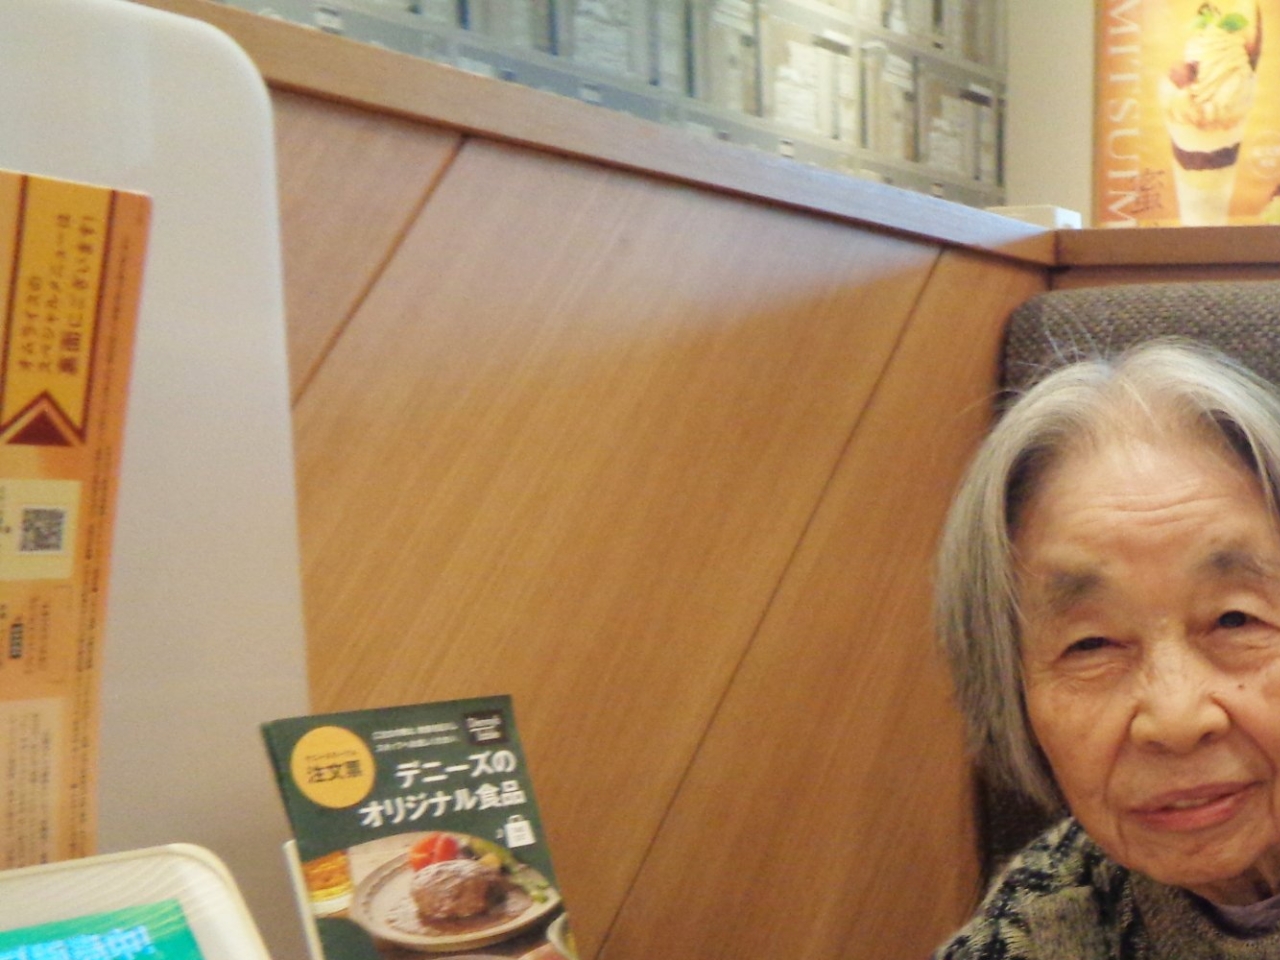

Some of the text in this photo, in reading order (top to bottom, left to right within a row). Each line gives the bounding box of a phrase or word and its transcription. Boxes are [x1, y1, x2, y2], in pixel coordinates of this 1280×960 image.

[394, 749, 518, 789] デニーズの
[356, 779, 528, 829] オリジナル食品
